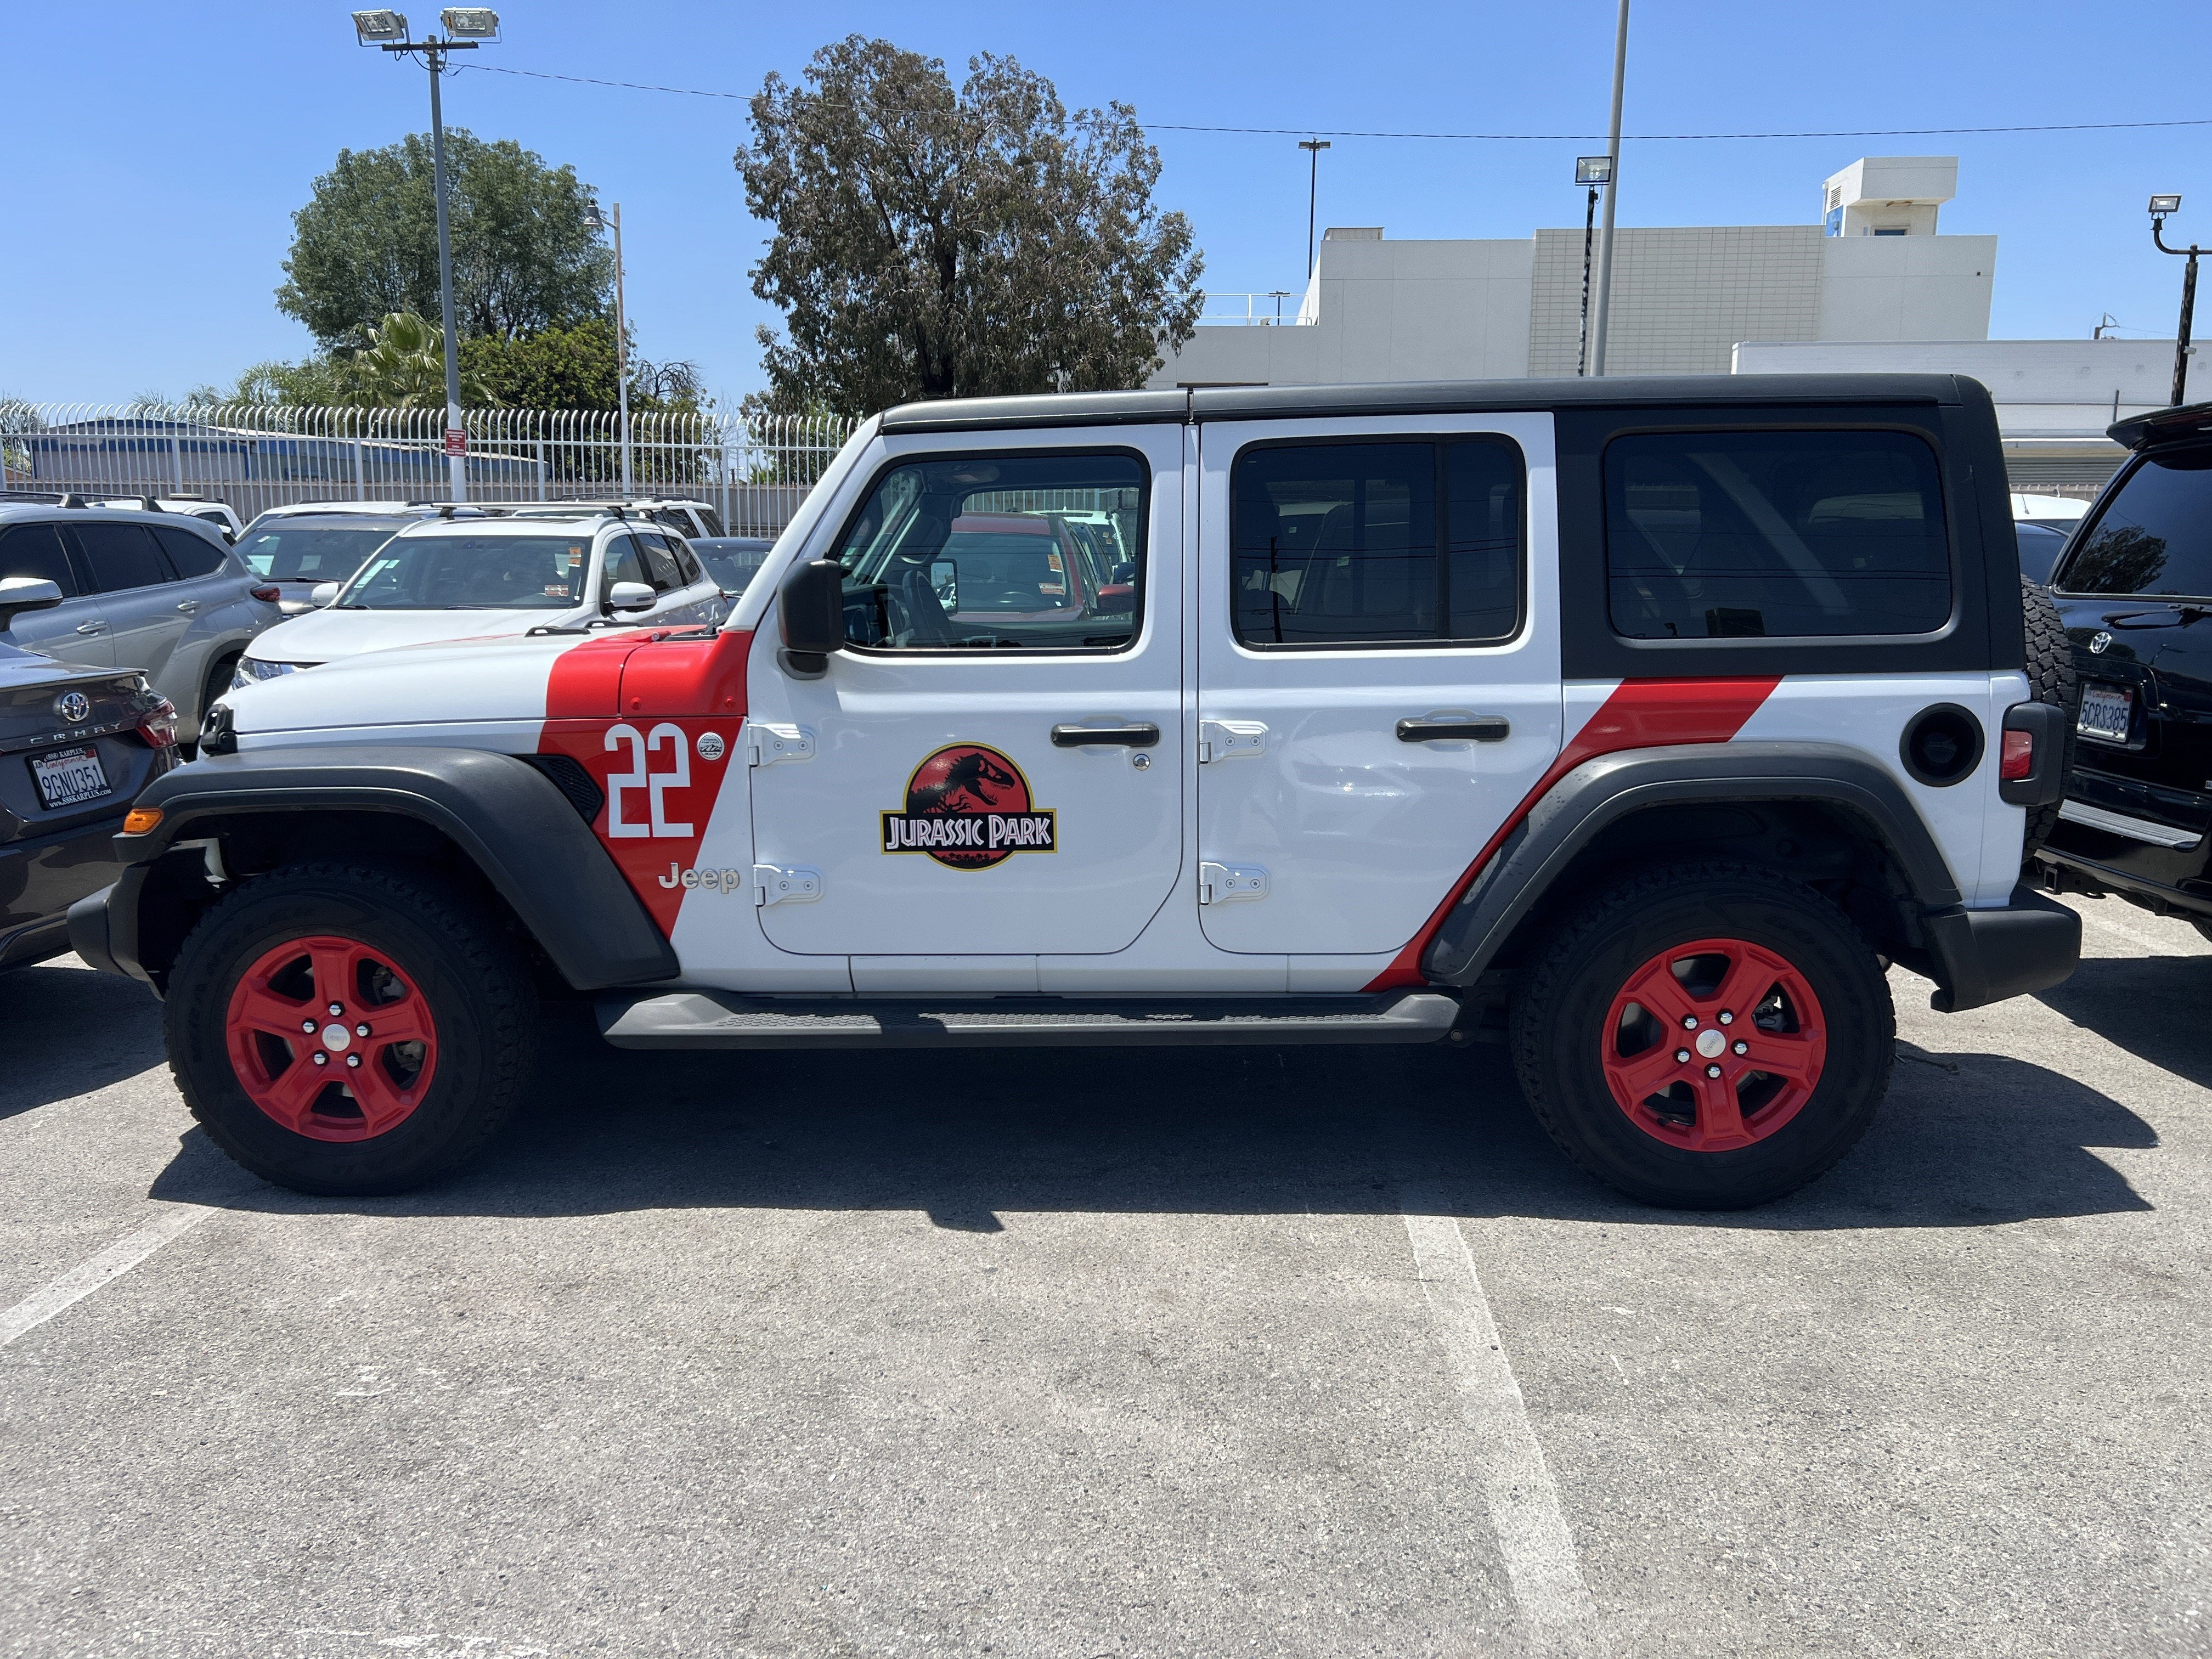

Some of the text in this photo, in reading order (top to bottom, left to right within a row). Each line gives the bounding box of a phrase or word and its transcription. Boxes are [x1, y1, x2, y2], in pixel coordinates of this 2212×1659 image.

[2092, 691, 2121, 702] California
[2080, 701, 2129, 731] 5CRS385
[46, 752, 59, 760] (888)
[59, 748, 83, 758] KARPLUS
[46, 755, 83, 770] California
[42, 765, 106, 802] 9GNU351
[603, 722, 694, 838] 22
[885, 814, 1052, 850] JURASSIC PARK
[658, 862, 741, 894] Jeep
[1703, 1032, 1722, 1054] Jeep
